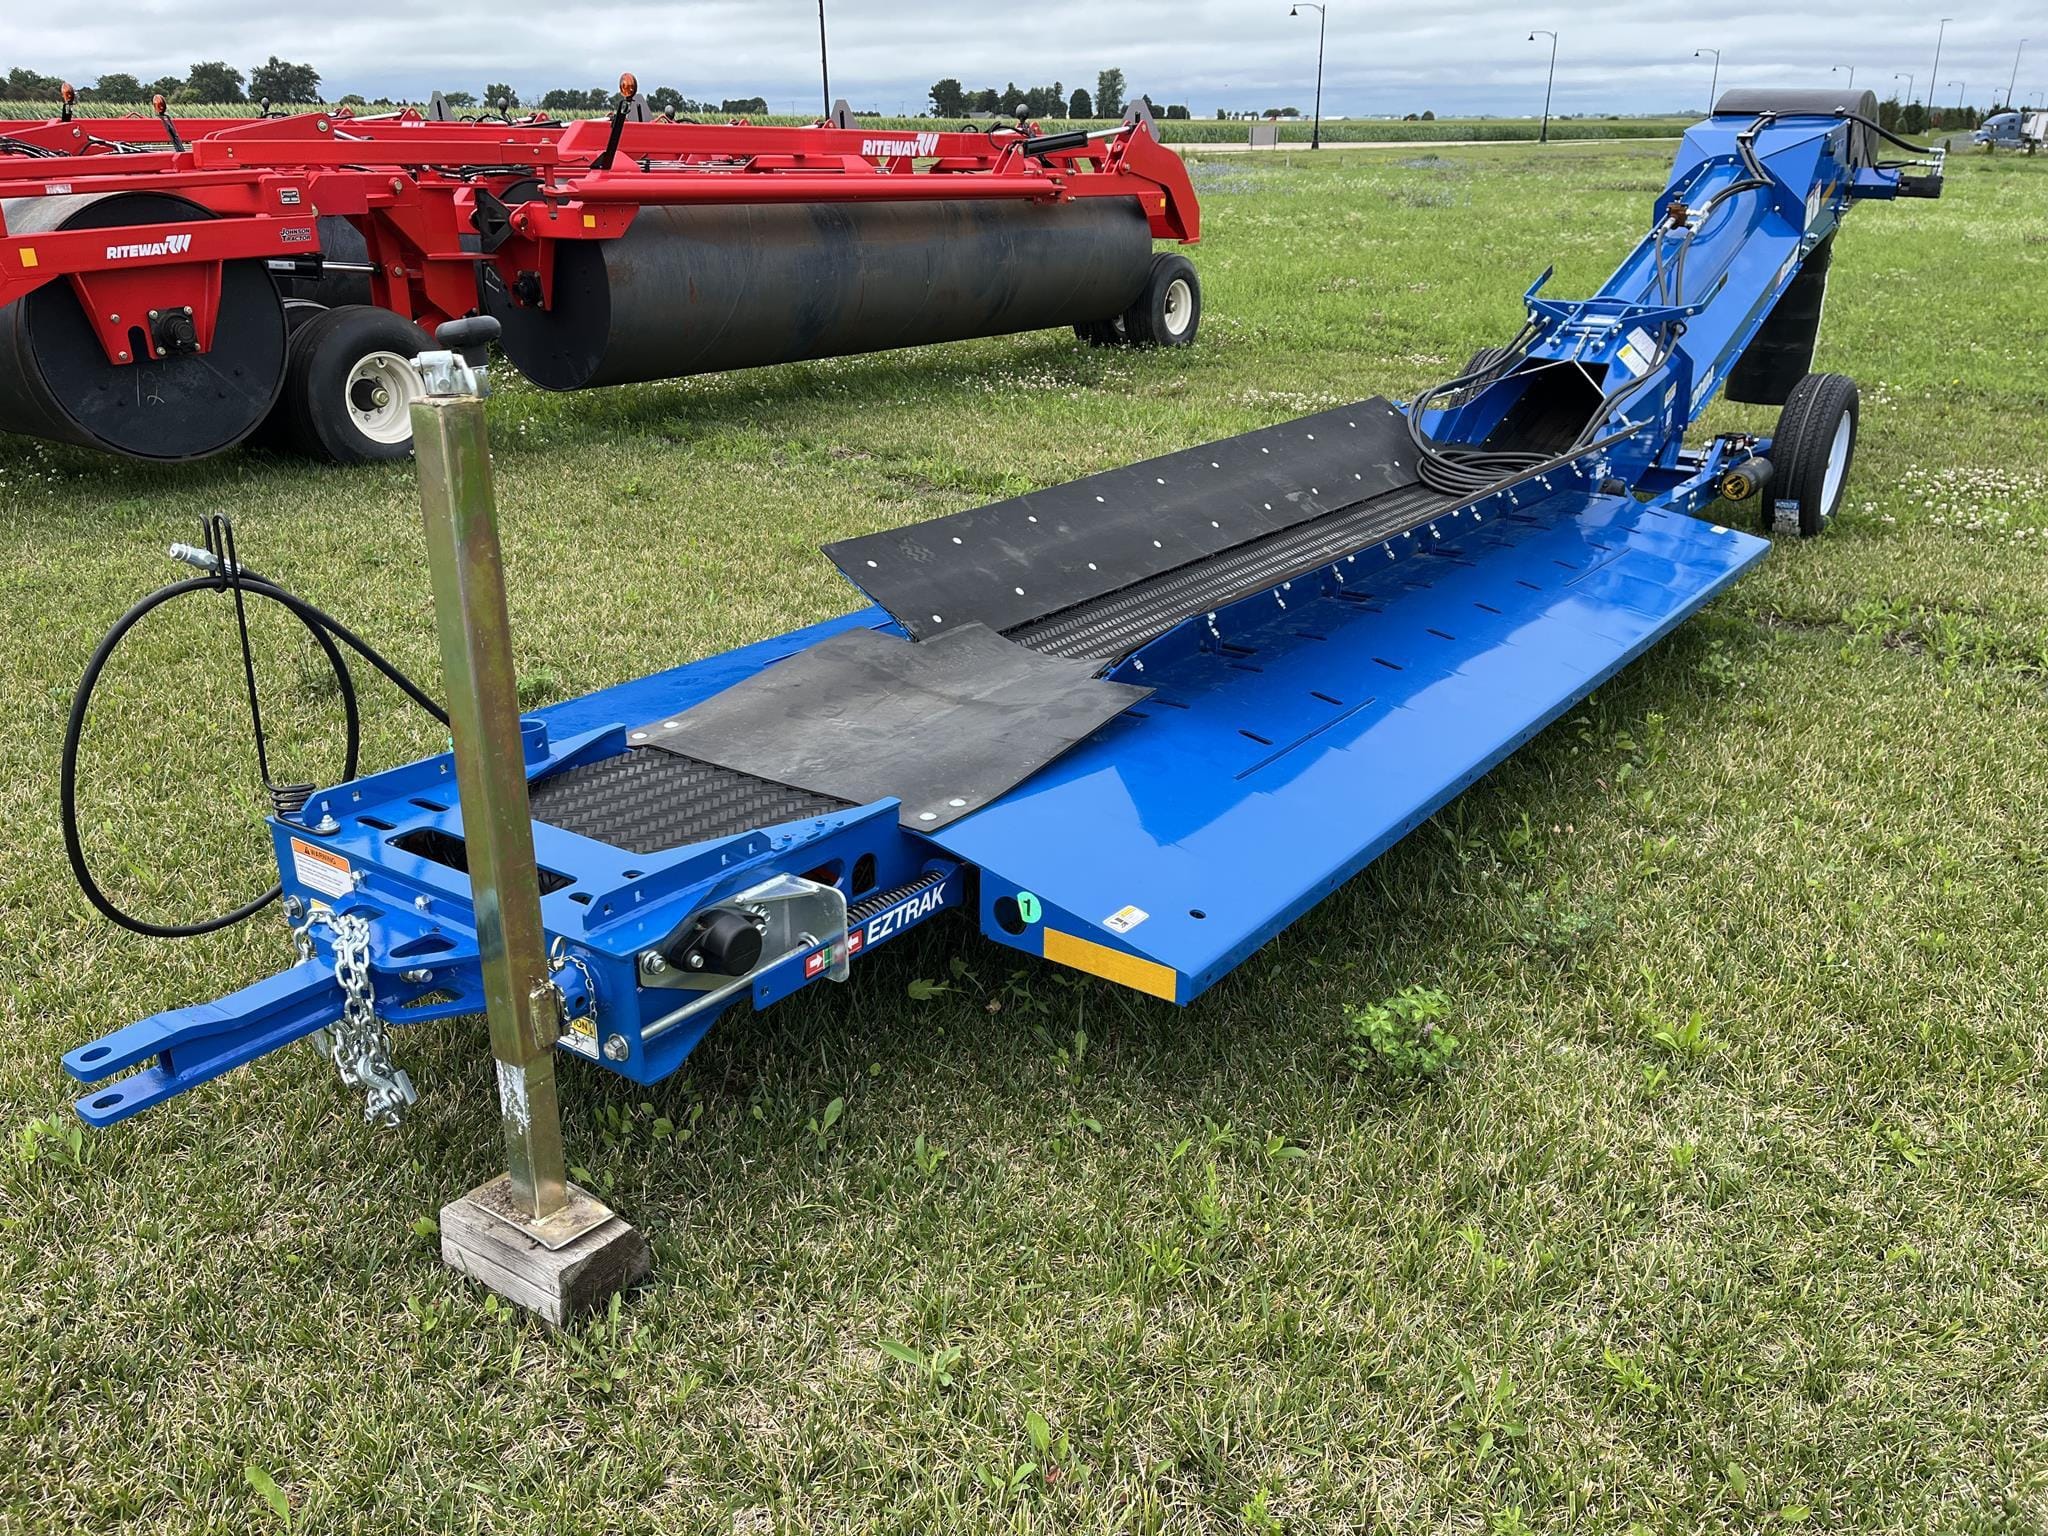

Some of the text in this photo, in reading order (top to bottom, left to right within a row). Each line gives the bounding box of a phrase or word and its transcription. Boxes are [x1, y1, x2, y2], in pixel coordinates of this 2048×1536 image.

[861, 139, 919, 157] RITEWAY
[106, 242, 169, 260] RITEWAY
[866, 882, 946, 945] EZTRAK
[1023, 898, 1031, 917] 1
